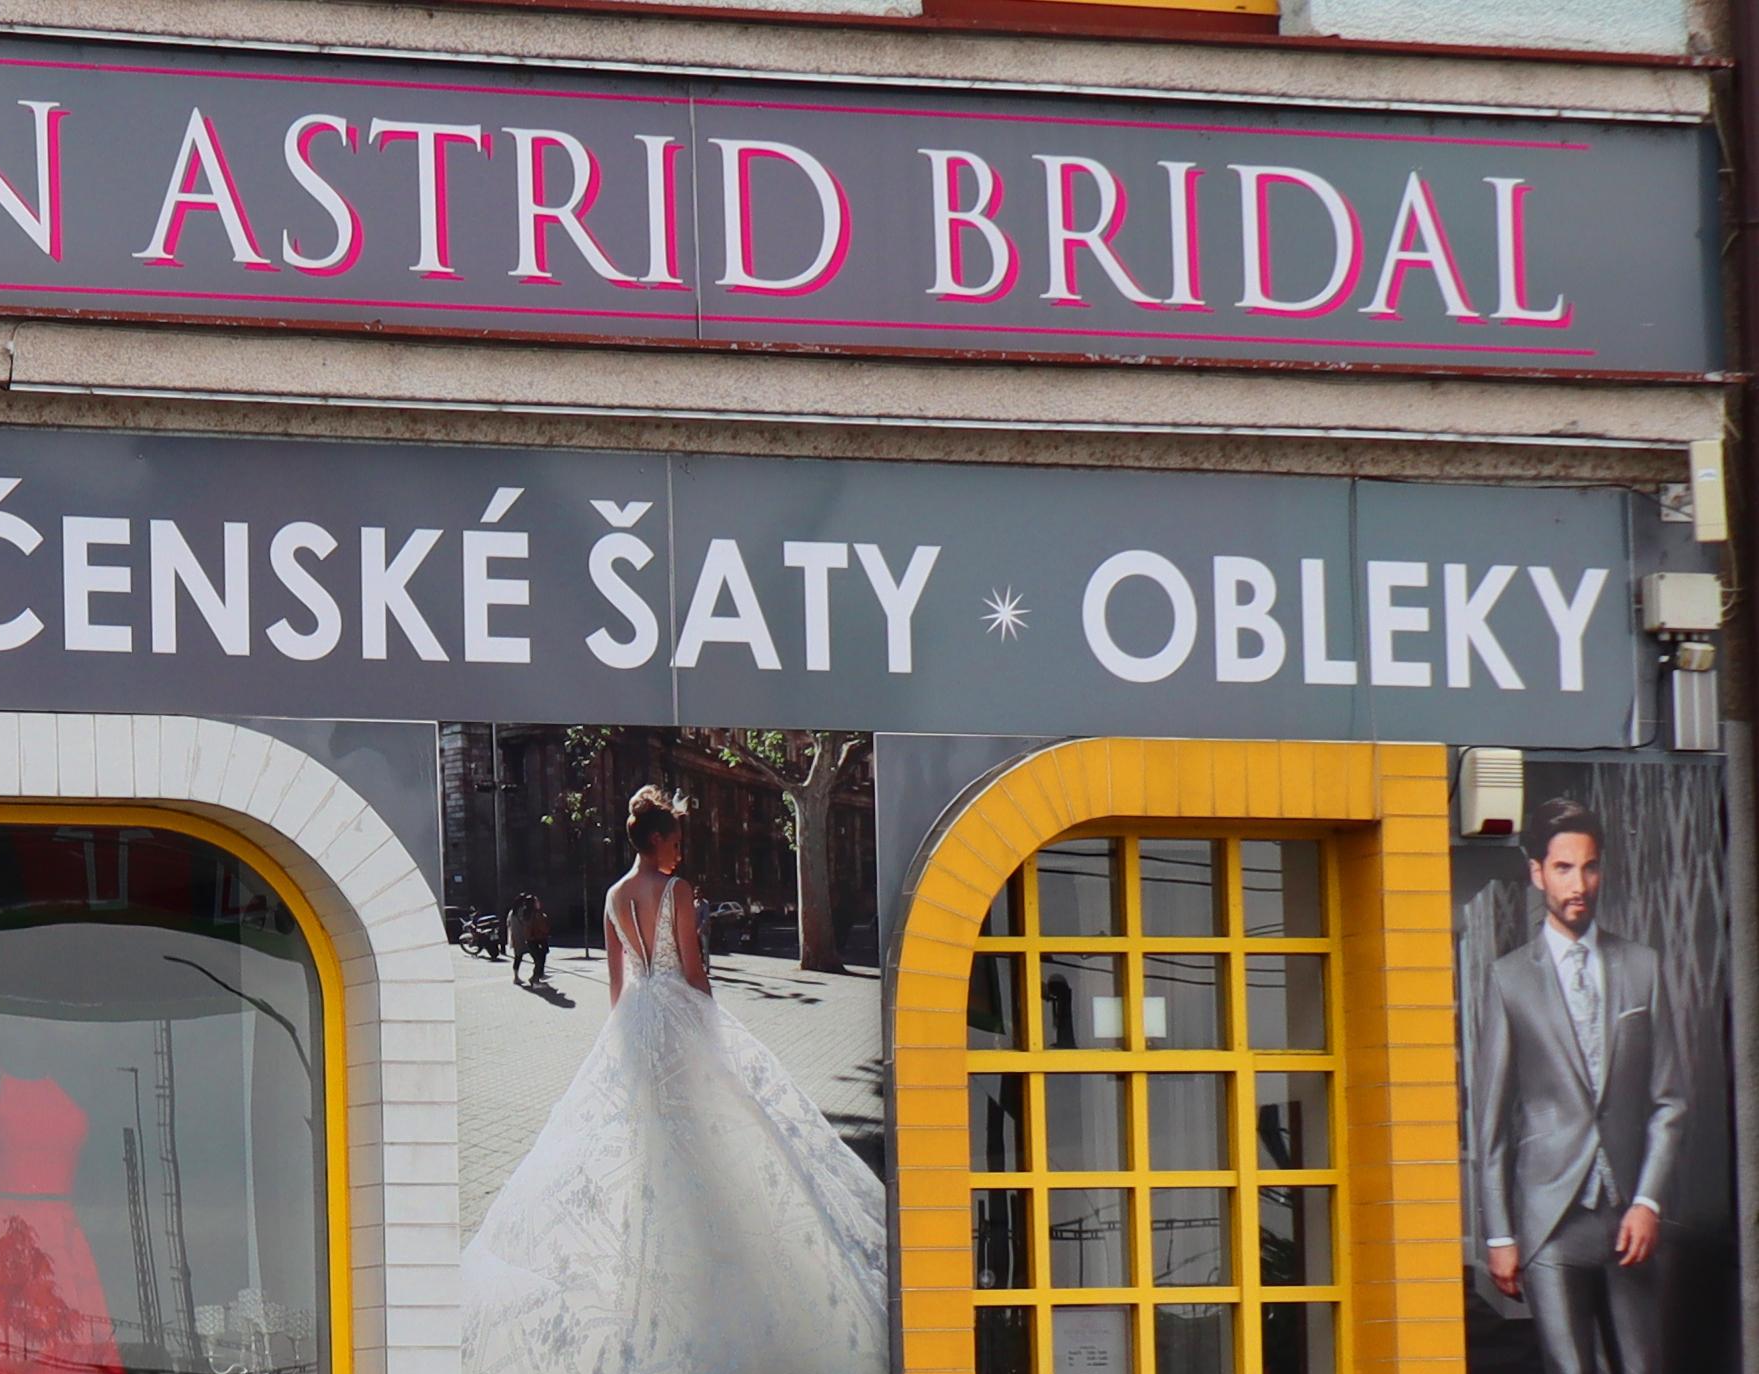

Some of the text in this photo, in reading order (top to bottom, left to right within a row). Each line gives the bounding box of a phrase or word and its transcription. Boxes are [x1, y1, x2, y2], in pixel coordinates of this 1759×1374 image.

[131, 106, 849, 298] ASTRID
[917, 148, 1573, 328] BRIDAL
[585, 500, 942, 673] ŠATY
[1082, 549, 1608, 692] OBLEKY
